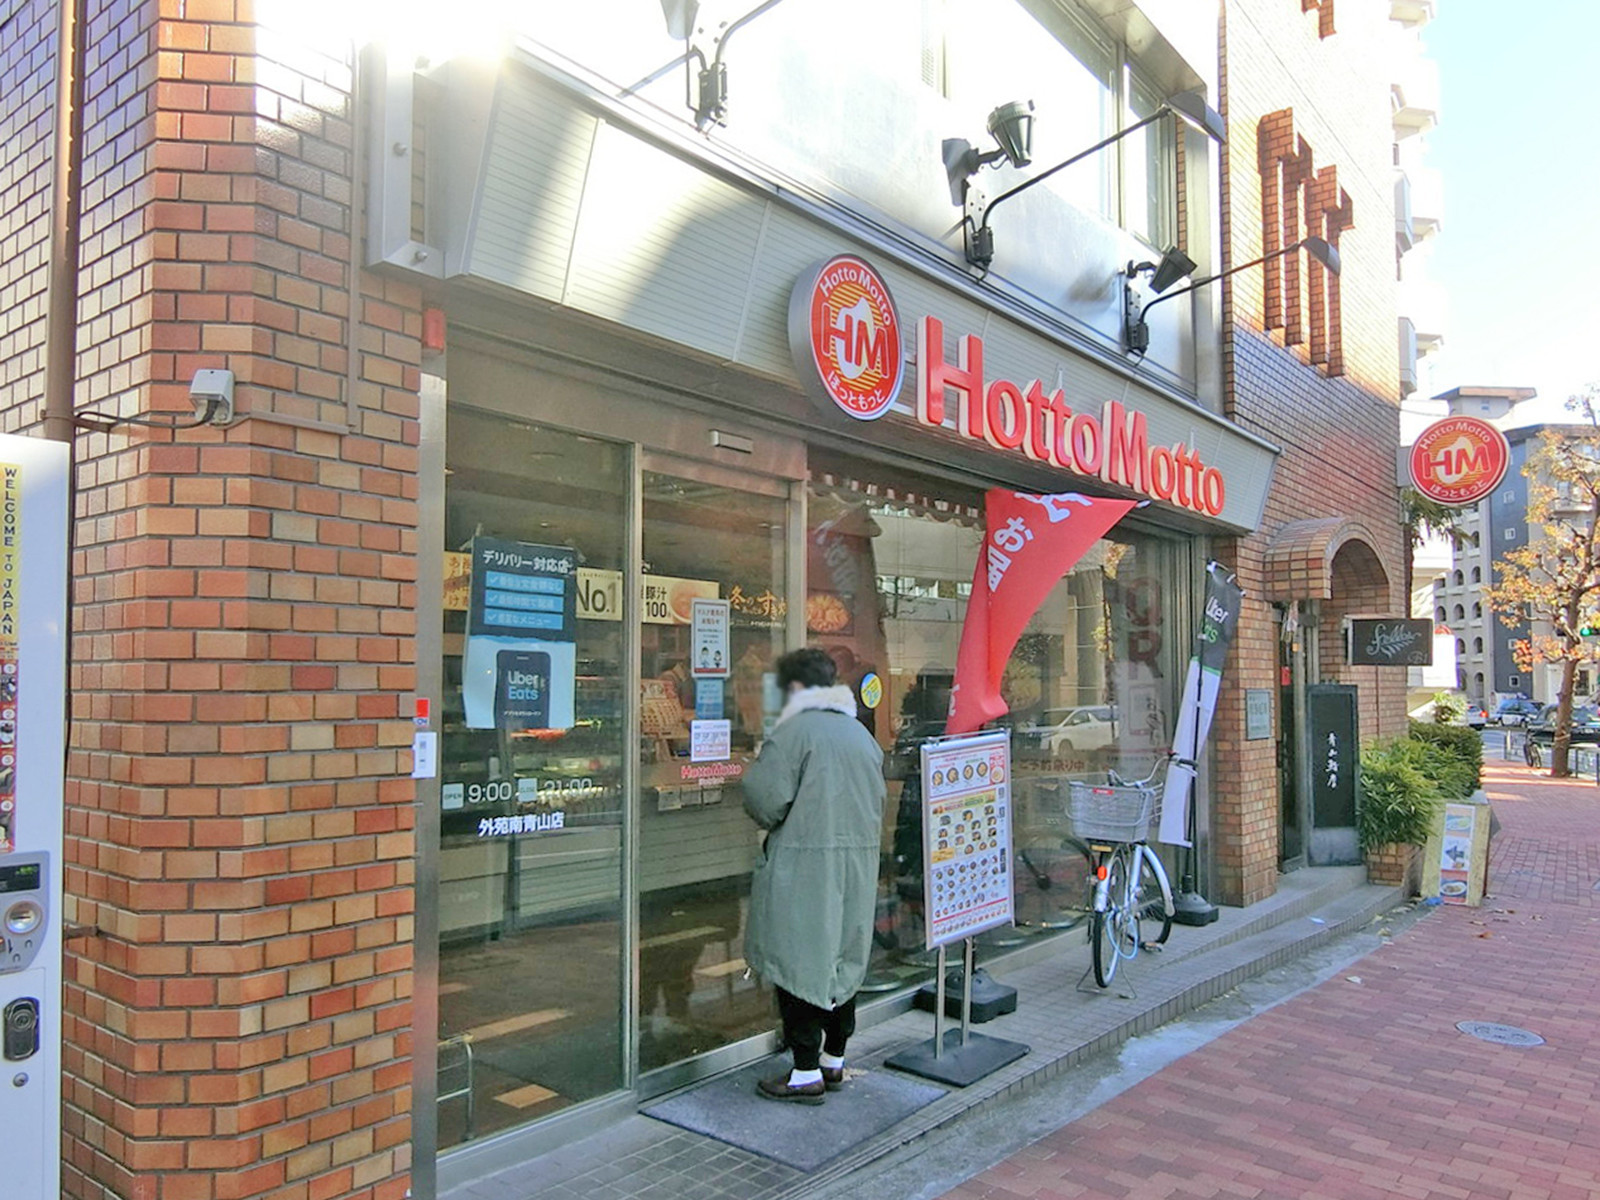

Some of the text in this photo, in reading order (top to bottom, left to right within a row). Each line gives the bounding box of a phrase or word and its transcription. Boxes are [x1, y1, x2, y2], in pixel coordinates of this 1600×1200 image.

[827, 370, 885, 410] ほっともっと
[4, 468, 17, 546] WELCOME
[4, 554, 13, 572] TO
[2, 579, 14, 634] JAPAN
[646, 601, 667, 618] 100
[507, 670, 539, 685] Uber
[508, 686, 539, 700] Eats
[468, 781, 512, 803] 9:00
[478, 811, 565, 837] 外苑南青山店
